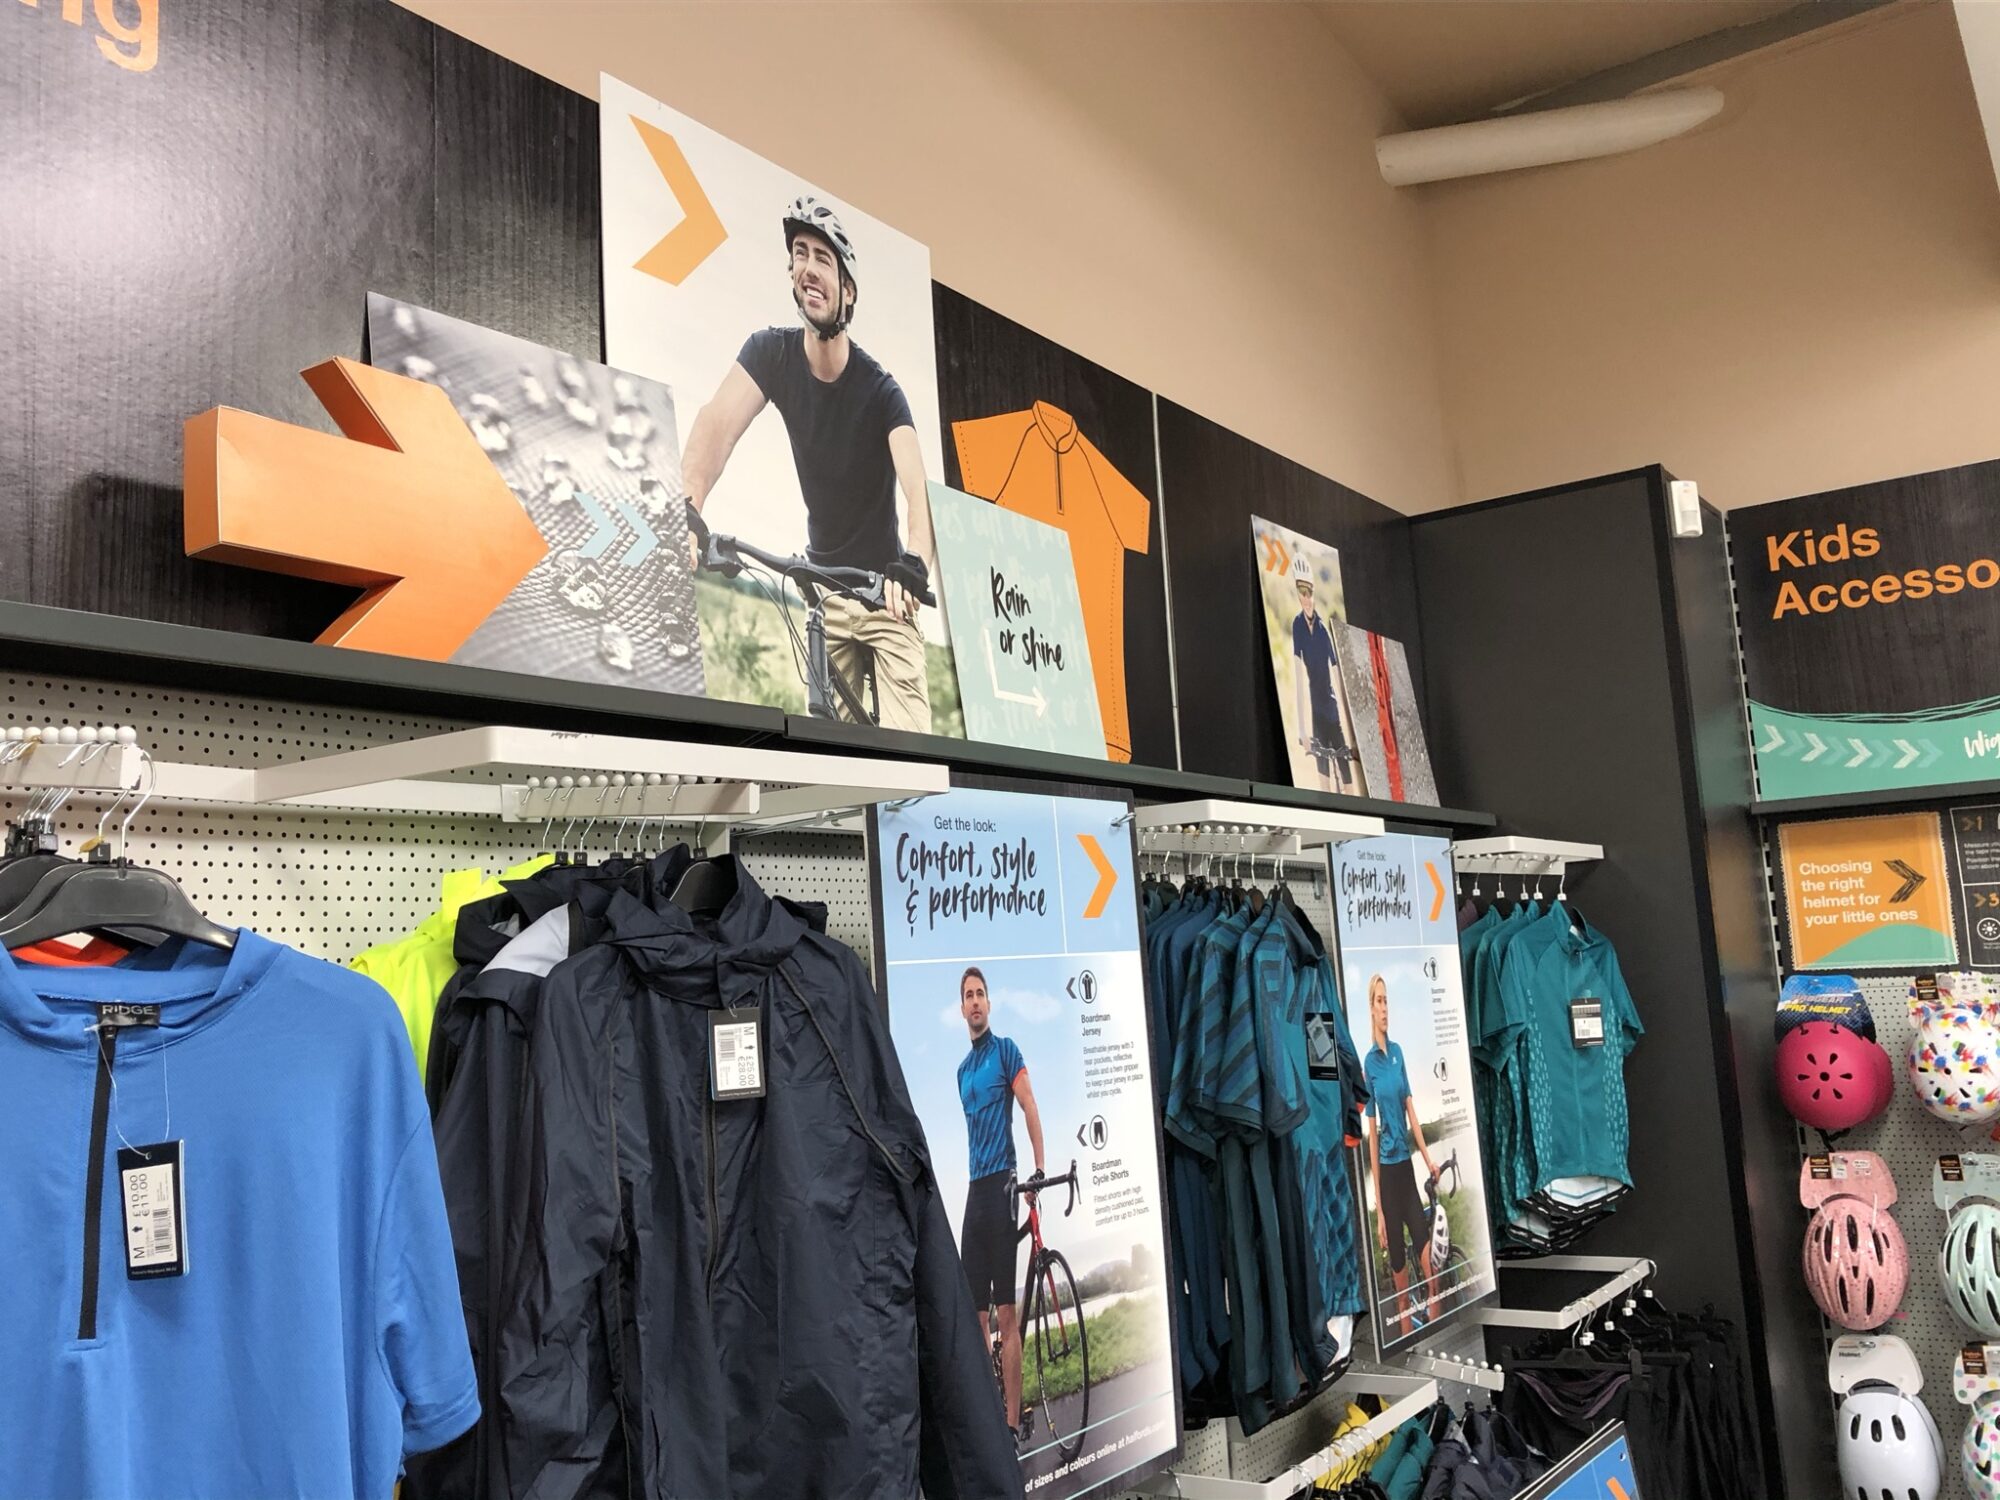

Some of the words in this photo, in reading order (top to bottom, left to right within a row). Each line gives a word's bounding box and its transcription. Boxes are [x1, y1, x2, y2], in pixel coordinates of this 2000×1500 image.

[1766, 523, 1881, 572] Kids
[990, 565, 1031, 624] Rain
[1772, 558, 2000, 620] Accesso
[1000, 628, 1015, 655] or
[934, 816, 952, 830] Get
[955, 817, 971, 831] the
[973, 818, 996, 832] look:
[98, 848, 103, 857] L
[896, 832, 982, 883] Comfort,
[990, 837, 1037, 891] style
[1799, 860, 1872, 875] Choosing
[1801, 880, 1825, 892] the
[1829, 877, 1865, 891] right
[905, 879, 919, 938] &
[929, 882, 1047, 930] performance
[1803, 895, 1855, 908] helmet
[1859, 893, 1880, 905] for
[1357, 896, 1411, 928] performance
[1804, 913, 1839, 928] your
[1842, 910, 1875, 924] little
[1879, 909, 1919, 922] ones
[102, 1004, 157, 1015] RIDGE
[1809, 1005, 1852, 1014] HELMET
[1081, 1013, 1111, 1024] Boardman
[743, 1026, 755, 1036] M
[1081, 1027, 1102, 1036] Jersey
[1092, 1158, 1121, 1172] Boardman
[1092, 1175, 1109, 1186] Cycle
[1110, 1169, 1129, 1181] Shorts
[130, 1174, 141, 1217] £10.00
[139, 1173, 150, 1217] €11.00
[133, 1246, 146, 1260] M
[1024, 1478, 1033, 1493] of
[1034, 1472, 1054, 1487] sizes
[1054, 1463, 1068, 1479] and
[1069, 1452, 1096, 1472] colours
[1096, 1443, 1117, 1459] online
[1117, 1438, 1125, 1451] at
